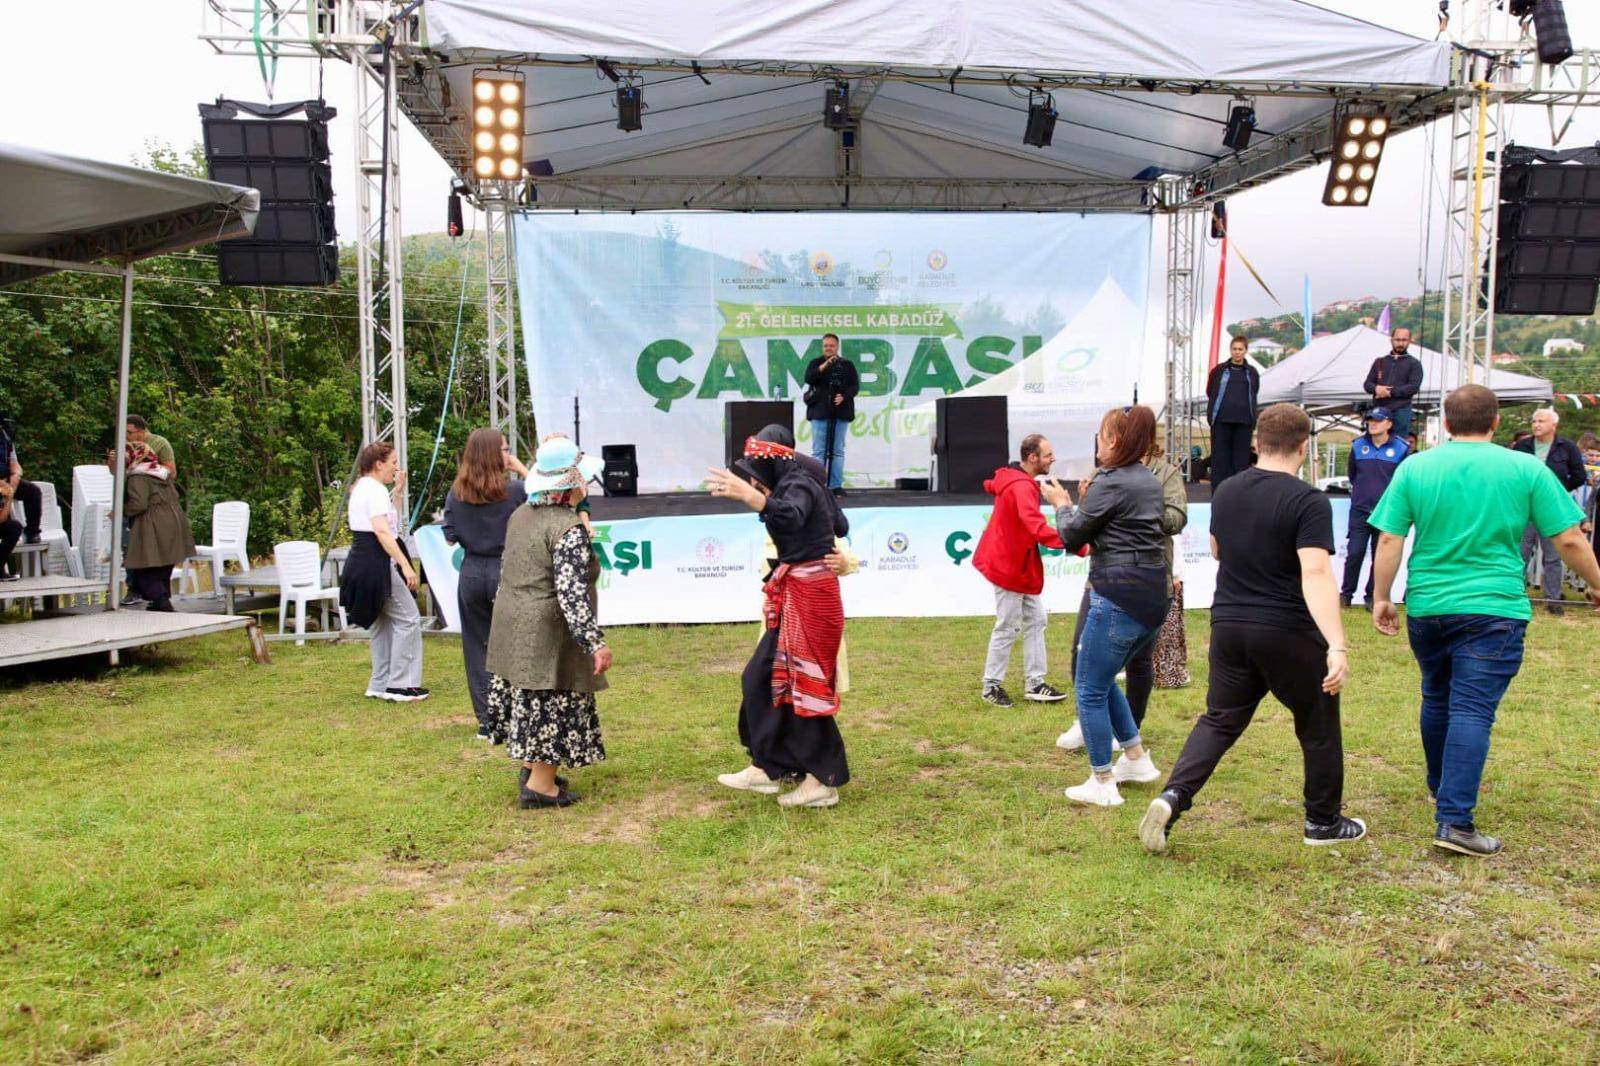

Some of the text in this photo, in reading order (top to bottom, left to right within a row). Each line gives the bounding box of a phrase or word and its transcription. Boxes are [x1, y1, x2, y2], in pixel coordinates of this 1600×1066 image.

[736, 310, 944, 328] 21. GELENEKSEL KABADÜZ
